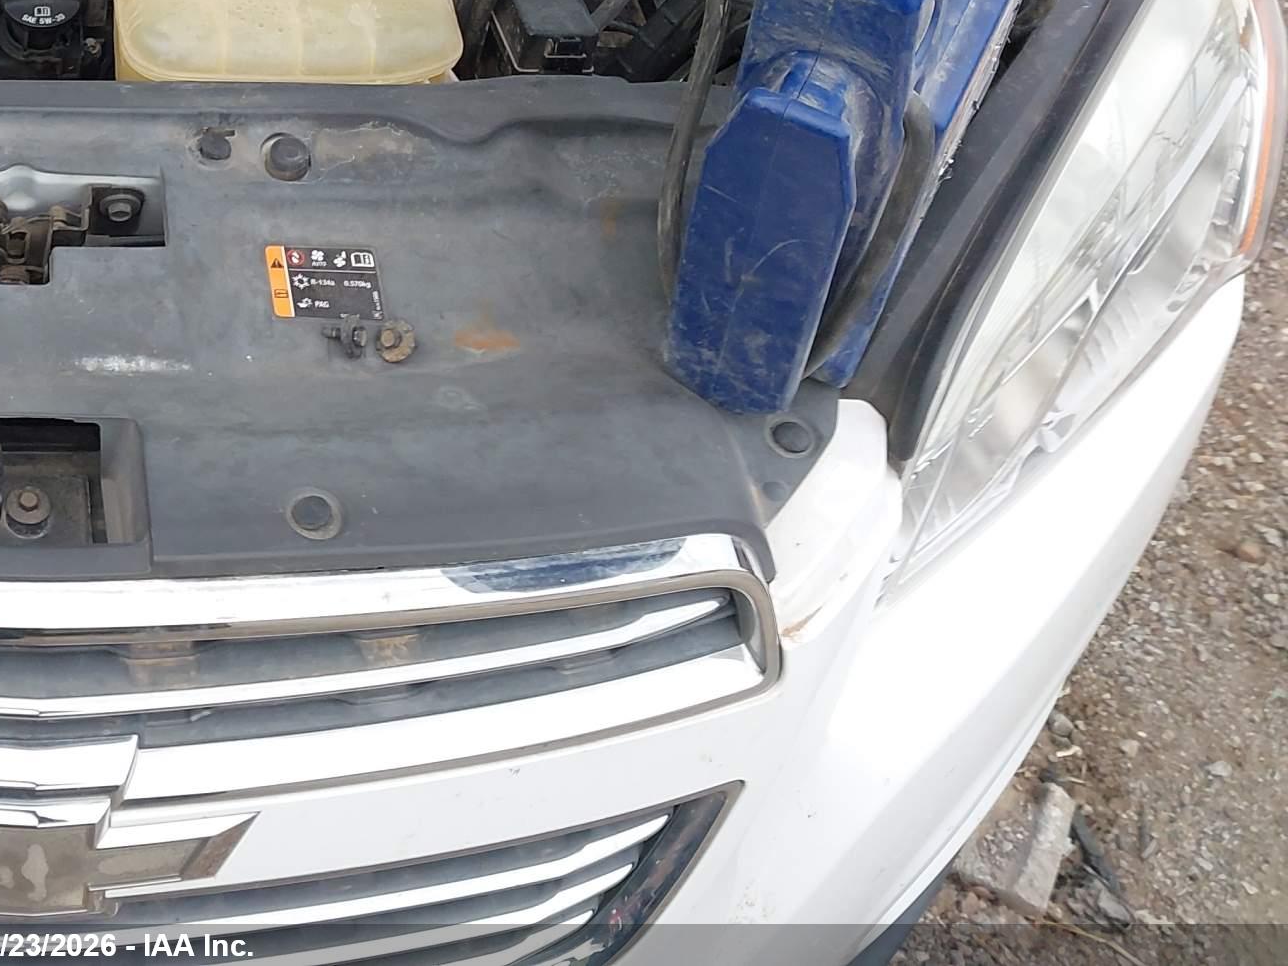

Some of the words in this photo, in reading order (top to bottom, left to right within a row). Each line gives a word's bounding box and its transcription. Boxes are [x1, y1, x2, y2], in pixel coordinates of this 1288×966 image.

[21, 14, 37, 24] SAE
[39, 13, 65, 24] 5W-30
[314, 300, 330, 309] PAG
